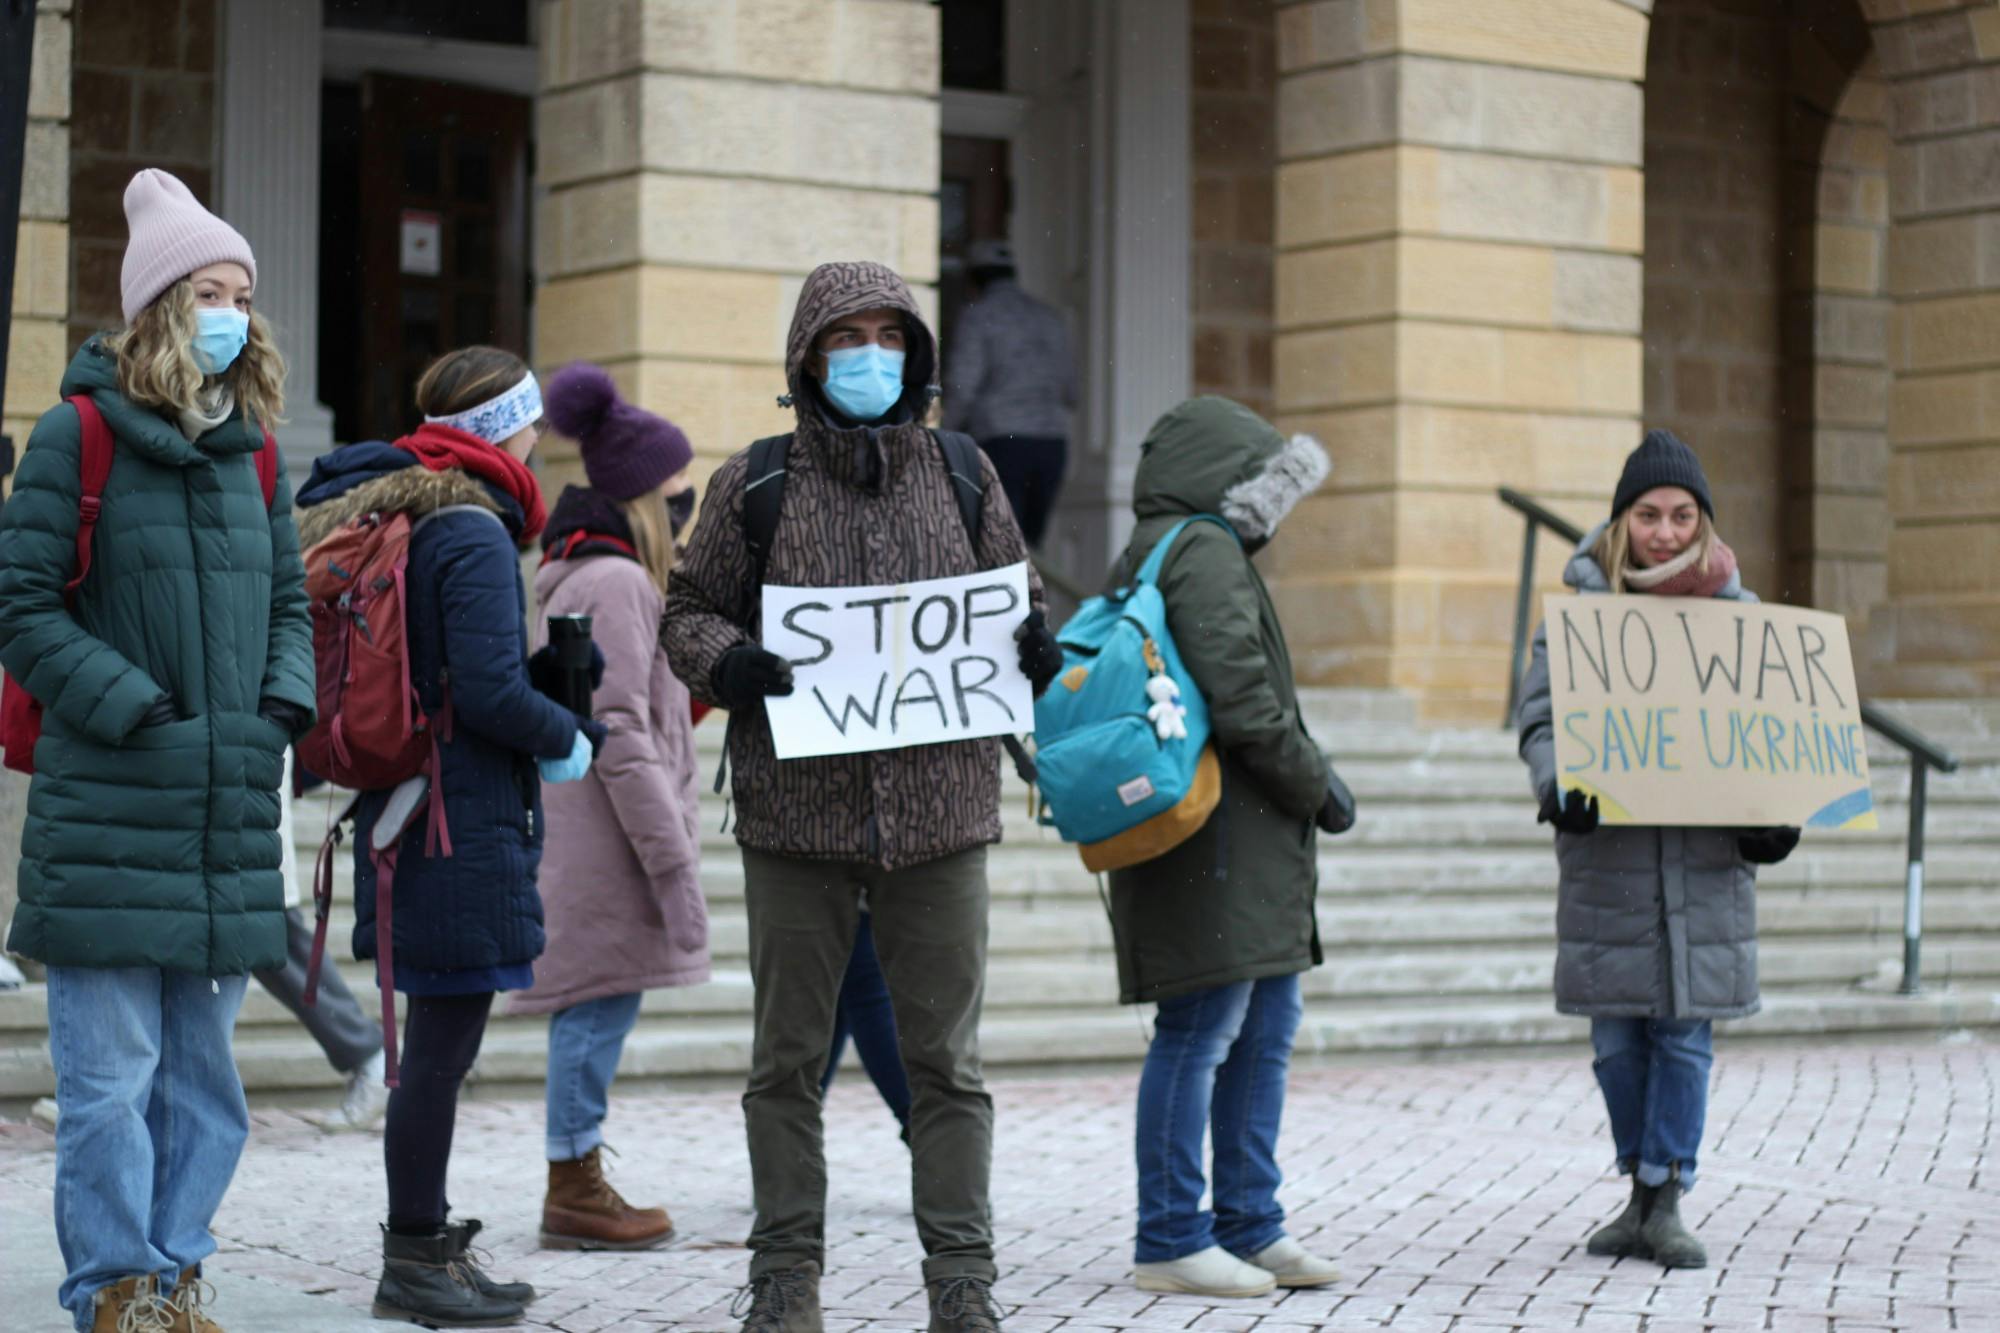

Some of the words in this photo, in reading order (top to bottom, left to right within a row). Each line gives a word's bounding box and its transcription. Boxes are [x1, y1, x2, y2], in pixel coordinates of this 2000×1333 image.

[782, 584, 1018, 665] STOP
[1561, 609, 1657, 693] NO
[1677, 612, 1846, 708] WAR
[813, 656, 1014, 735] WAR
[1564, 707, 1682, 773] SAVE
